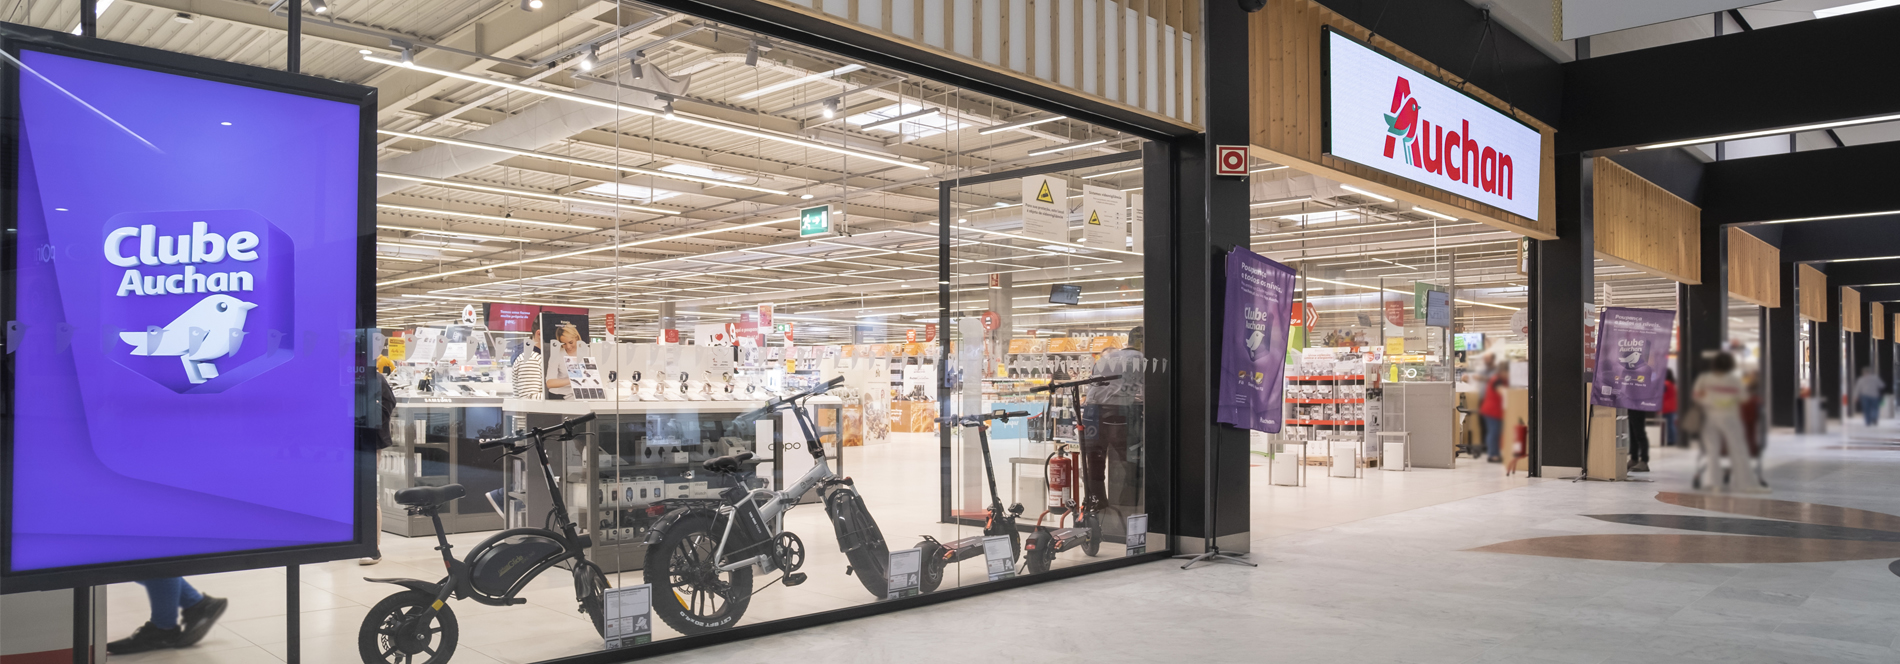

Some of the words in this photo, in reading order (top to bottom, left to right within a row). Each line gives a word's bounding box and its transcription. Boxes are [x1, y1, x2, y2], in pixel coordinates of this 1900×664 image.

[1383, 76, 1513, 200] Auchan
[104, 221, 259, 267] Clube
[116, 265, 254, 297] Auchan
[1245, 307, 1267, 321] Clube
[1618, 338, 1644, 347] Clube
[768, 442, 801, 452] opo
